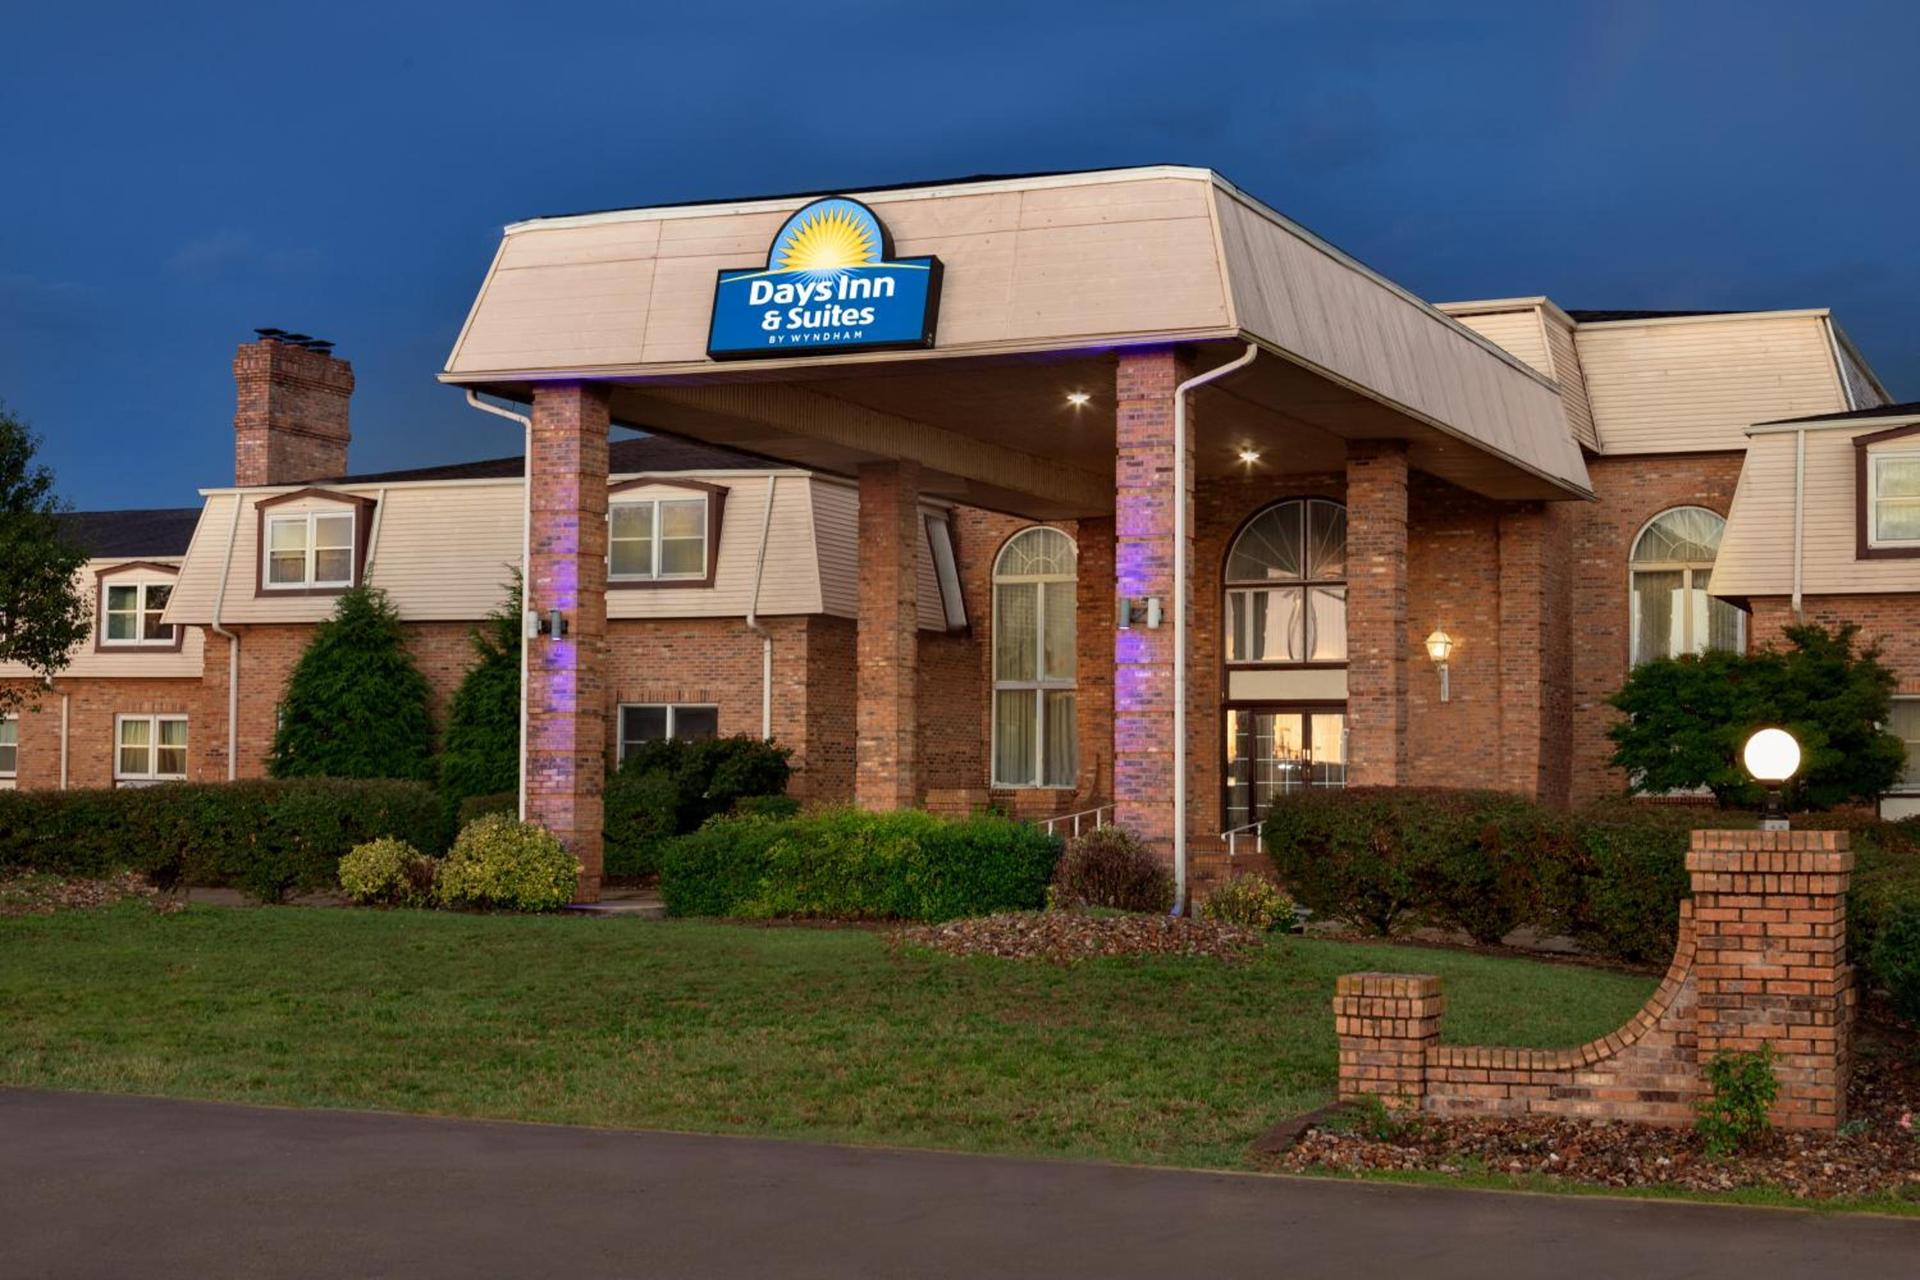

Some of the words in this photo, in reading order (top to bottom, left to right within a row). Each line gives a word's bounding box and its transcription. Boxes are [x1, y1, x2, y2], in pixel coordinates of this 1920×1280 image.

[749, 279, 832, 307] Days
[838, 275, 895, 300] Inn
[761, 310, 783, 331] &
[786, 304, 875, 330] Suites
[768, 335, 785, 344] BY
[791, 330, 863, 343] WYNDHAM
